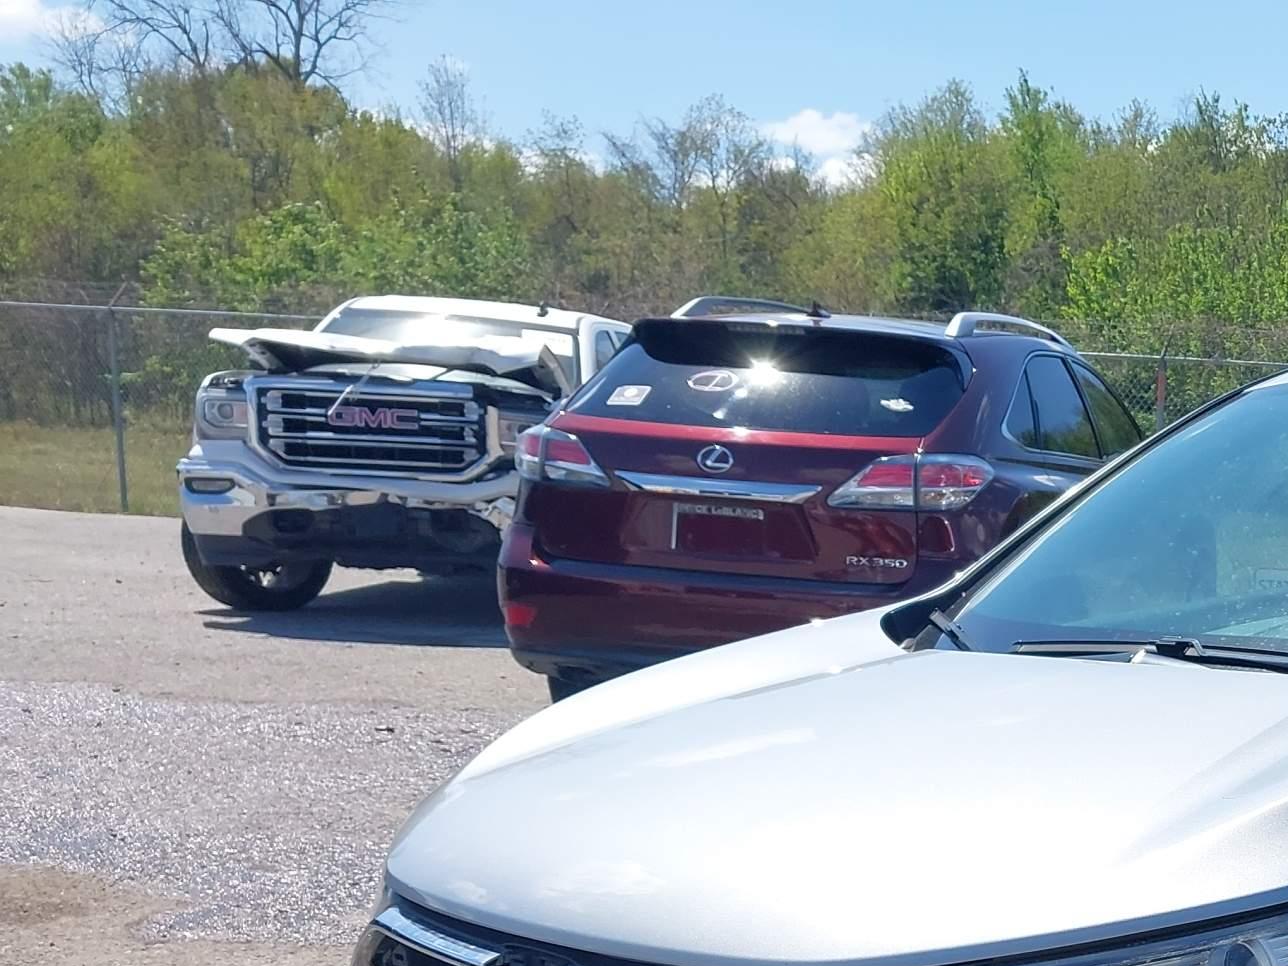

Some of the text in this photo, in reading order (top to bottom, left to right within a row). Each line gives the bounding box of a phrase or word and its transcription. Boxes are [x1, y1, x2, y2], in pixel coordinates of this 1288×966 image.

[328, 405, 419, 432] GMC
[846, 555, 909, 570] RX 350
